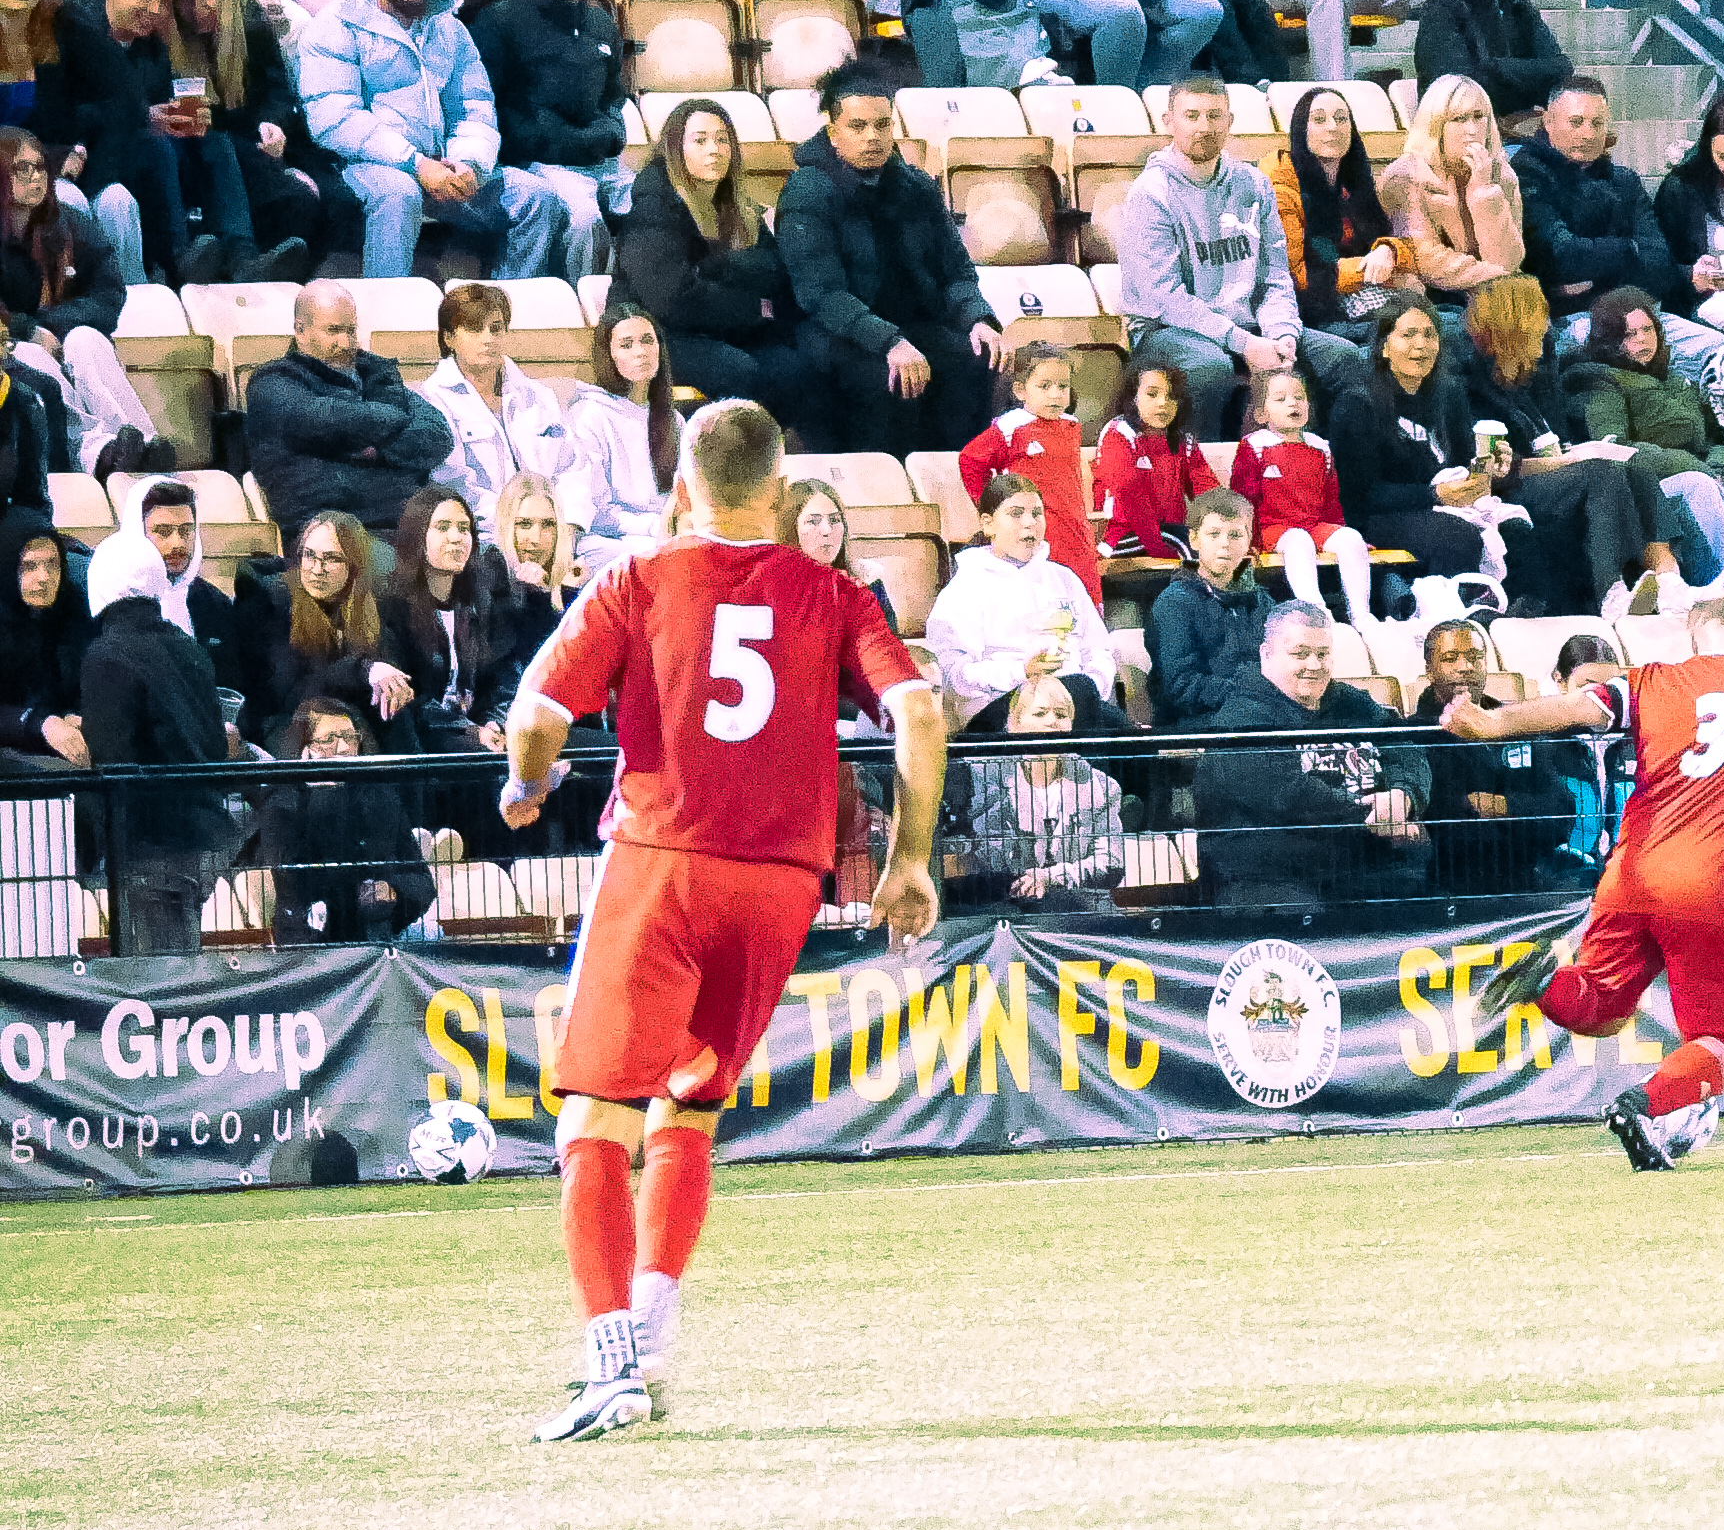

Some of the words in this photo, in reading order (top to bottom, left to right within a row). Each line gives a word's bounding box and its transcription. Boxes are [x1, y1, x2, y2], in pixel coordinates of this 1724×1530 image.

[703, 603, 776, 742] 5
[1215, 945, 1262, 1009] SLOUGH
[1265, 943, 1316, 976] TOWN
[101, 998, 326, 1091] Group
[788, 960, 1031, 1103] TOWN
[1057, 958, 1160, 1091] FC
[1213, 1031, 1248, 1088] SERVE
[1247, 1081, 1290, 1103] WITH
[1294, 1025, 1337, 1099] HONOUR
[0, 1096, 326, 1164] group.co.uk
